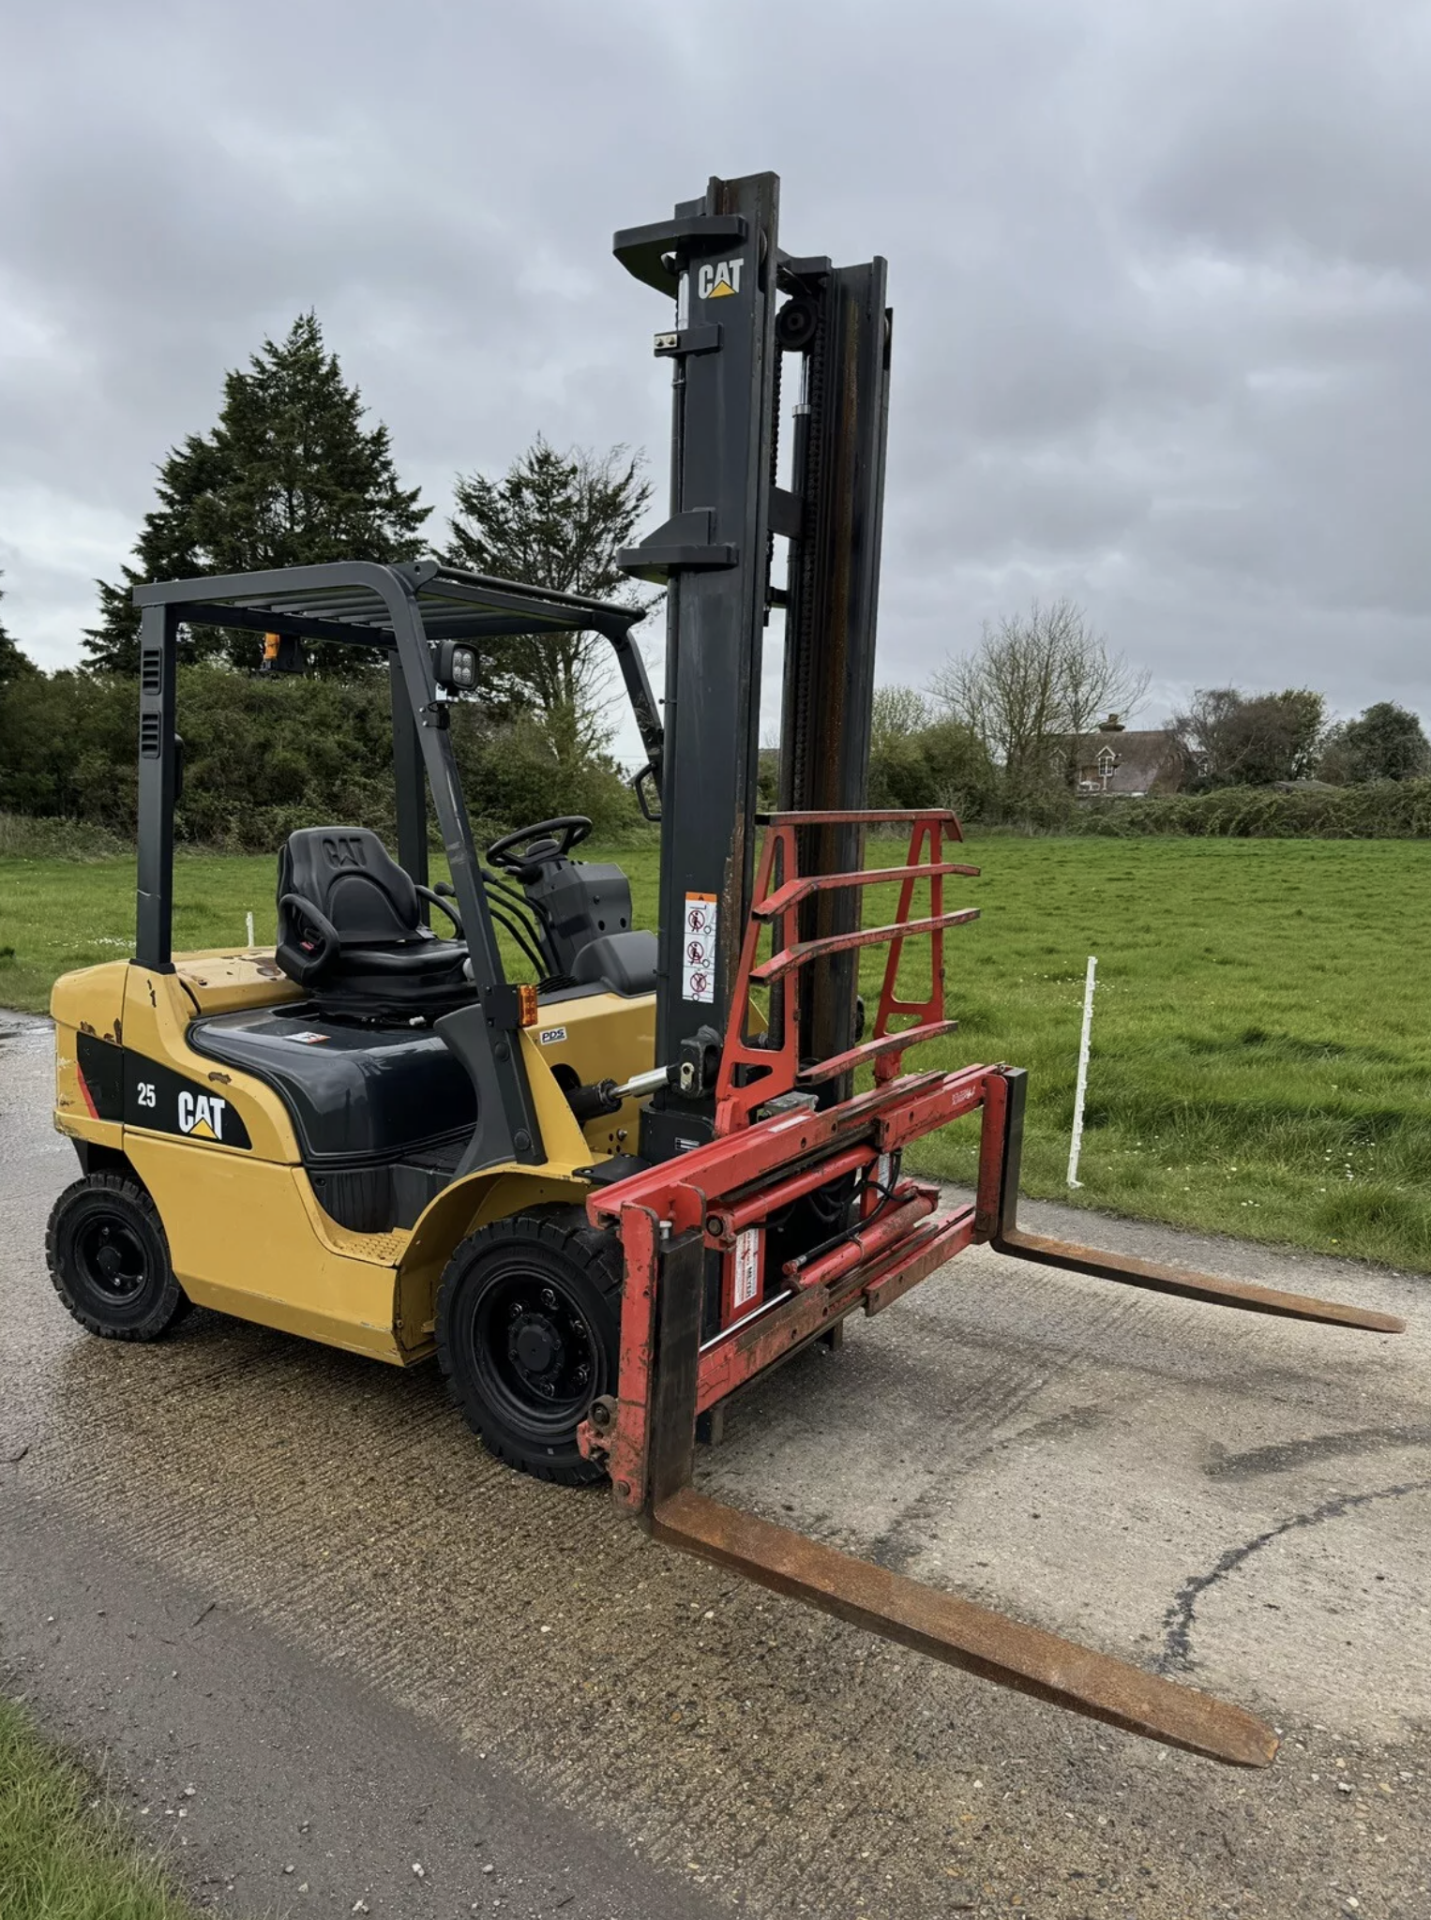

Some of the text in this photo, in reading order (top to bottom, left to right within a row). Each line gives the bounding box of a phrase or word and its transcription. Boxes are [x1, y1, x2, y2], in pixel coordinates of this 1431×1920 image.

[698, 258, 745, 300] CAT
[322, 837, 367, 870] CAT
[542, 1028, 566, 1042] PDS
[136, 1081, 157, 1108] 25
[177, 1090, 226, 1140] CAT
